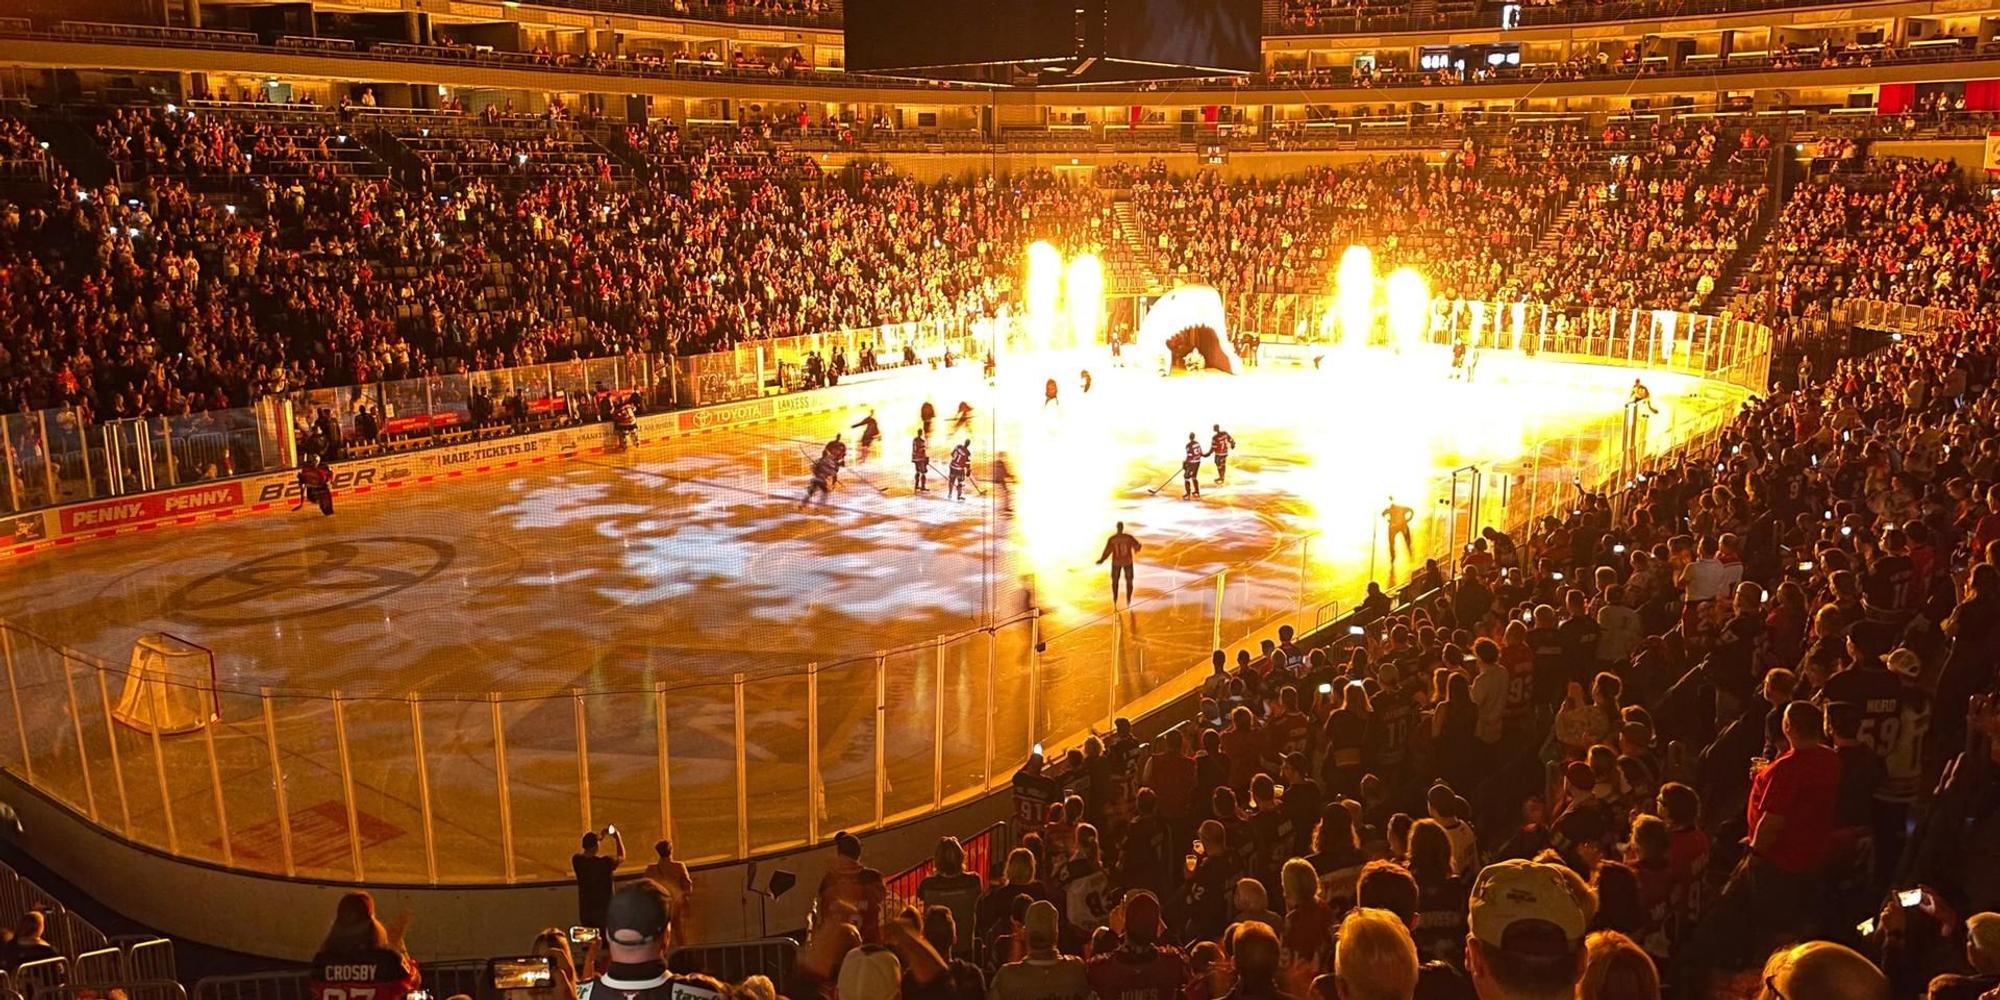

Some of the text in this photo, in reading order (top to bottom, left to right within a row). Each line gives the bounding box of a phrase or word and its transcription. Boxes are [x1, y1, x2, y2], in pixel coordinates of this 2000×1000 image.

[777, 396, 809, 410] LANXESS
[715, 405, 761, 423] TOYOTA
[259, 467, 376, 502] BAER
[325, 964, 377, 981] CROSBY
